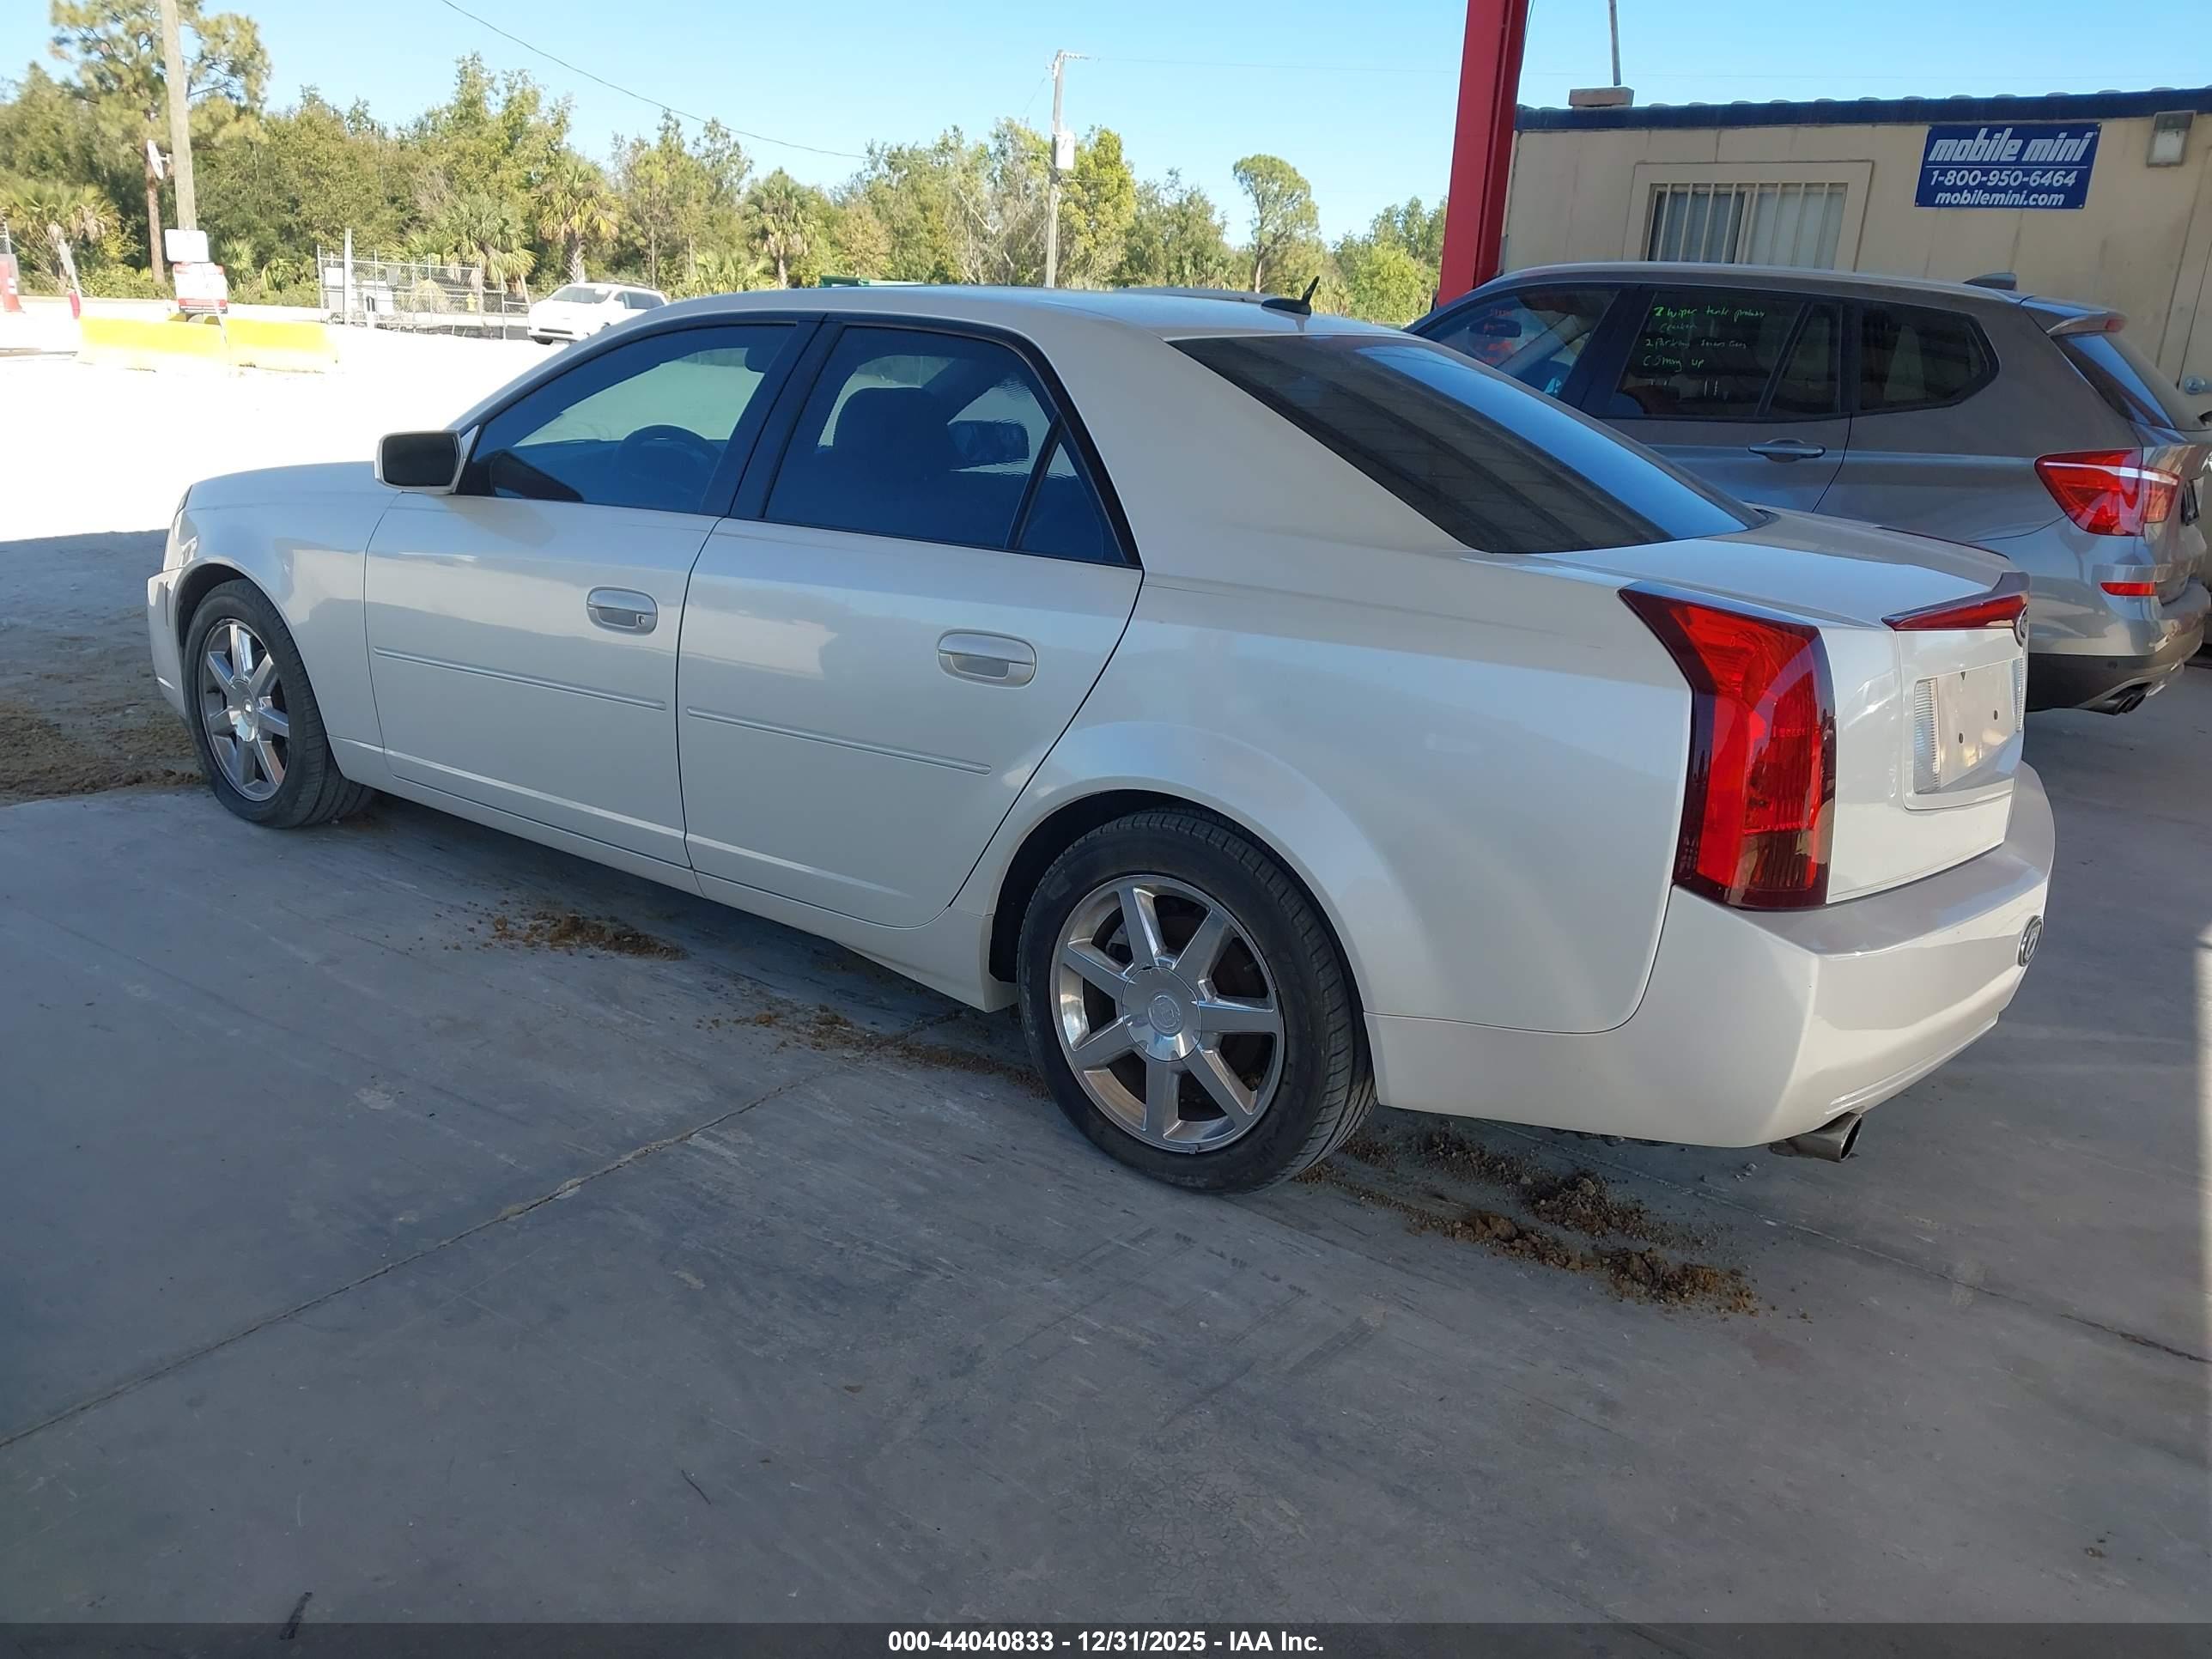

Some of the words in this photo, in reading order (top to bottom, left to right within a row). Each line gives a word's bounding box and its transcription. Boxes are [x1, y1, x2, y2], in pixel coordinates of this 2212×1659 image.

[1928, 127, 2023, 161] mobile
[2021, 132, 2094, 161] mini
[1930, 170, 2077, 186] 1-800-950-6464
[1935, 189, 2065, 206] mobilemini.com
